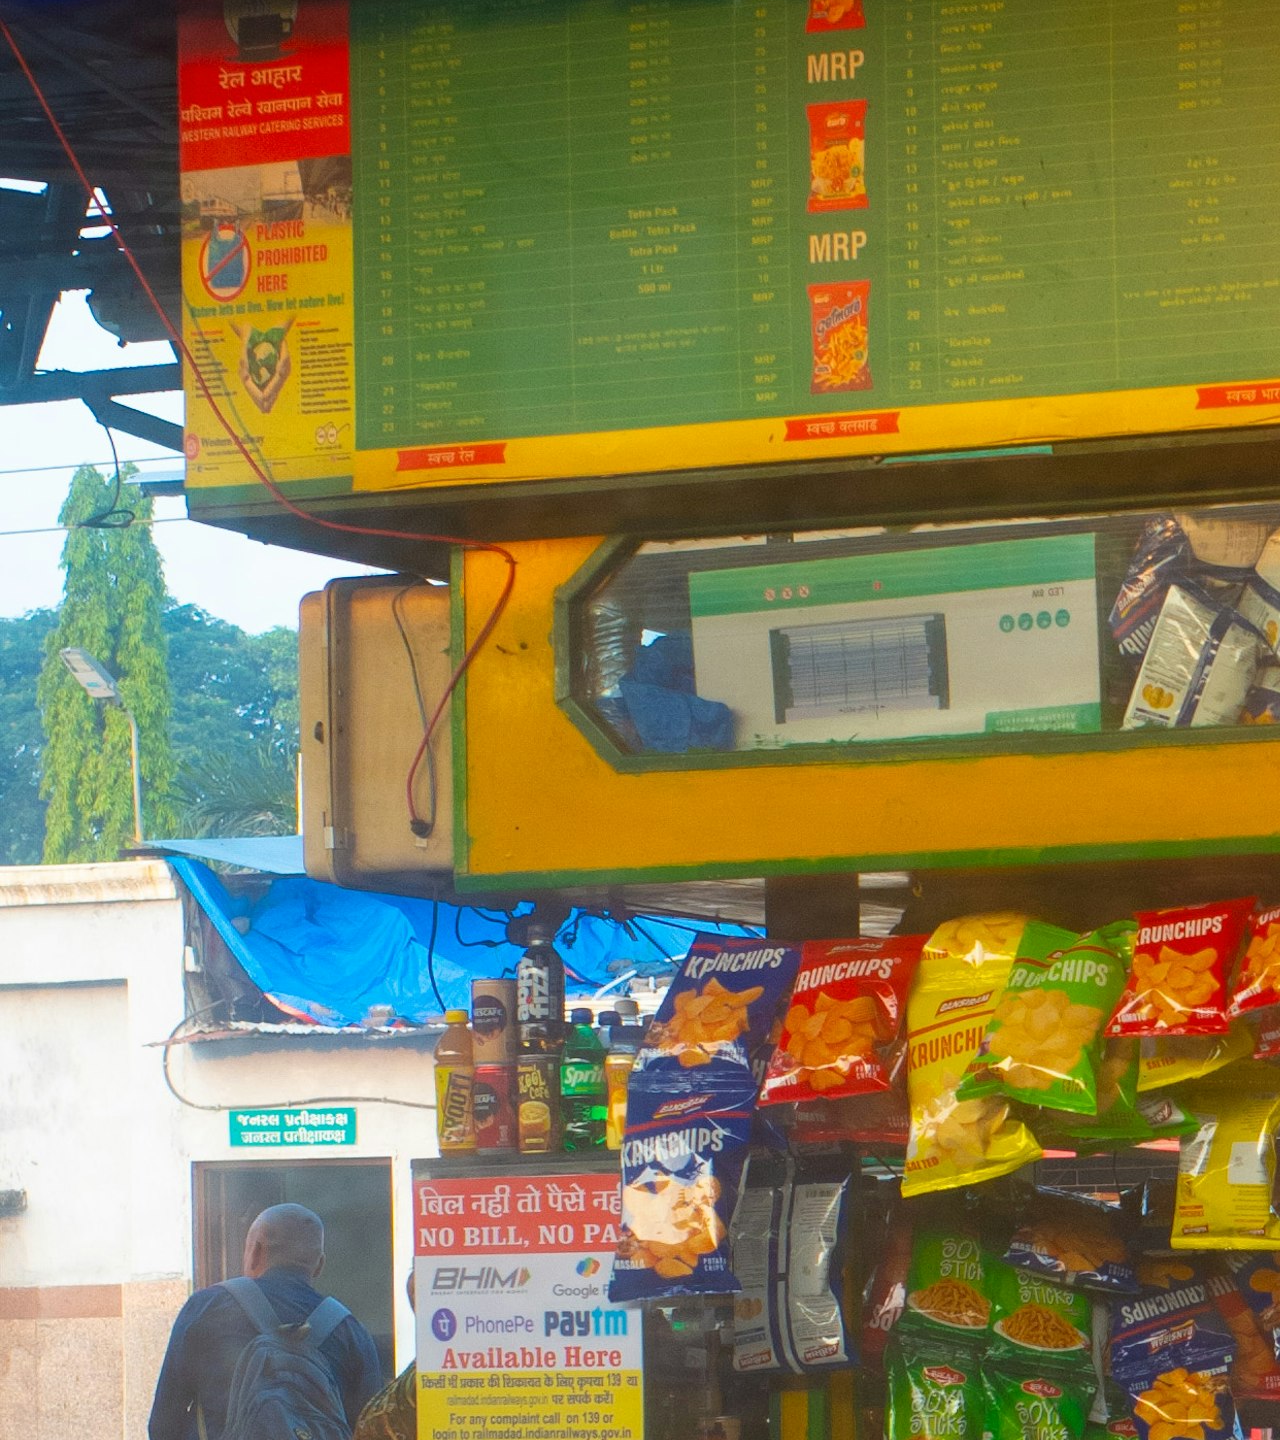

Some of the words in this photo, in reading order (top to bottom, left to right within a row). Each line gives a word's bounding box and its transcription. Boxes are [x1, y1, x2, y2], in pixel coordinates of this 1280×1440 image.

[806, 49, 866, 84] MRP
[218, 67, 246, 90] रेल
[251, 65, 303, 88] आहार
[222, 123, 258, 139] RAILWAY
[259, 118, 301, 135] CATERING
[302, 114, 343, 130] SERVICES
[256, 220, 305, 241] PLASTIC
[256, 244, 328, 268] PROHIBITED
[809, 230, 868, 264] MRP
[256, 274, 288, 293] HERE
[236, 1113, 280, 1127] જનરલ
[240, 1130, 281, 1144] जनरल
[419, 1186, 465, 1217] बिल
[516, 1184, 542, 1213] तो
[547, 1182, 585, 1213] पैसे
[419, 1227, 455, 1247] NO
[463, 1225, 531, 1248] BILL,
[538, 1224, 574, 1245] NO
[431, 1266, 518, 1290] BHIM
[552, 1283, 599, 1303] Google
[1120, 1283, 1206, 1327] KRUNCHIPS
[438, 1314, 451, 1334] पे
[465, 1316, 534, 1335] PhonePe
[441, 1347, 557, 1369] Available
[563, 1346, 622, 1368] Here
[421, 1376, 446, 1389] किसी
[460, 1377, 485, 1389] प्रकार
[487, 1374, 500, 1389] की
[503, 1374, 541, 1388] शिकायत
[543, 1374, 554, 1388] के
[556, 1374, 575, 1392] लिए
[576, 1376, 604, 1392] कृपया
[607, 1373, 622, 1385] 139
[626, 1376, 638, 1387] या
[551, 1395, 564, 1406] पर
[450, 1413, 469, 1425] For
[469, 1416, 488, 1427] any
[490, 1412, 541, 1427] complaint
[542, 1412, 561, 1425] call
[566, 1414, 580, 1424] on
[582, 1412, 600, 1424] 139
[602, 1415, 614, 1423] or
[909, 1414, 968, 1436] STICKS
[459, 1430, 470, 1440] to
